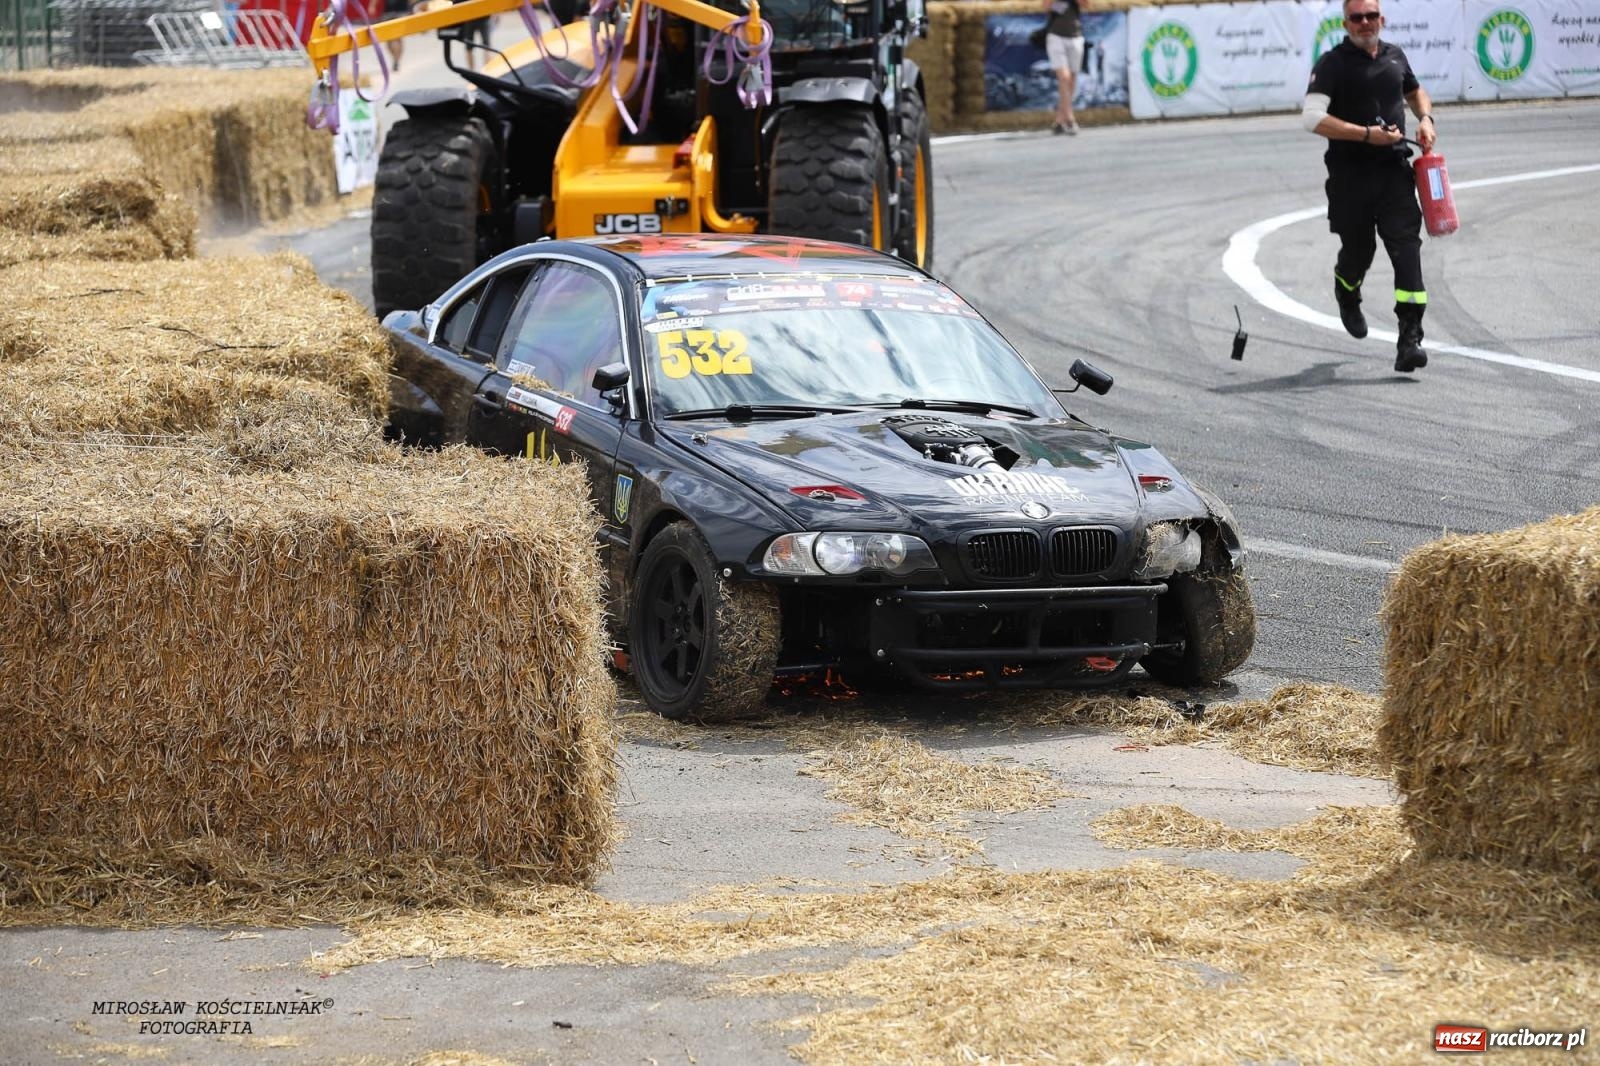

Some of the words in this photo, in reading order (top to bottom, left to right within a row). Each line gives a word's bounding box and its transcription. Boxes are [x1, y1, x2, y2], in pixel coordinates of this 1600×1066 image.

[595, 214, 662, 234] JCB
[657, 329, 752, 379] 532
[555, 410, 573, 431] 532
[944, 472, 1080, 497] UKRAINE
[964, 494, 1035, 506] RACING
[1042, 493, 1090, 504] TEAM
